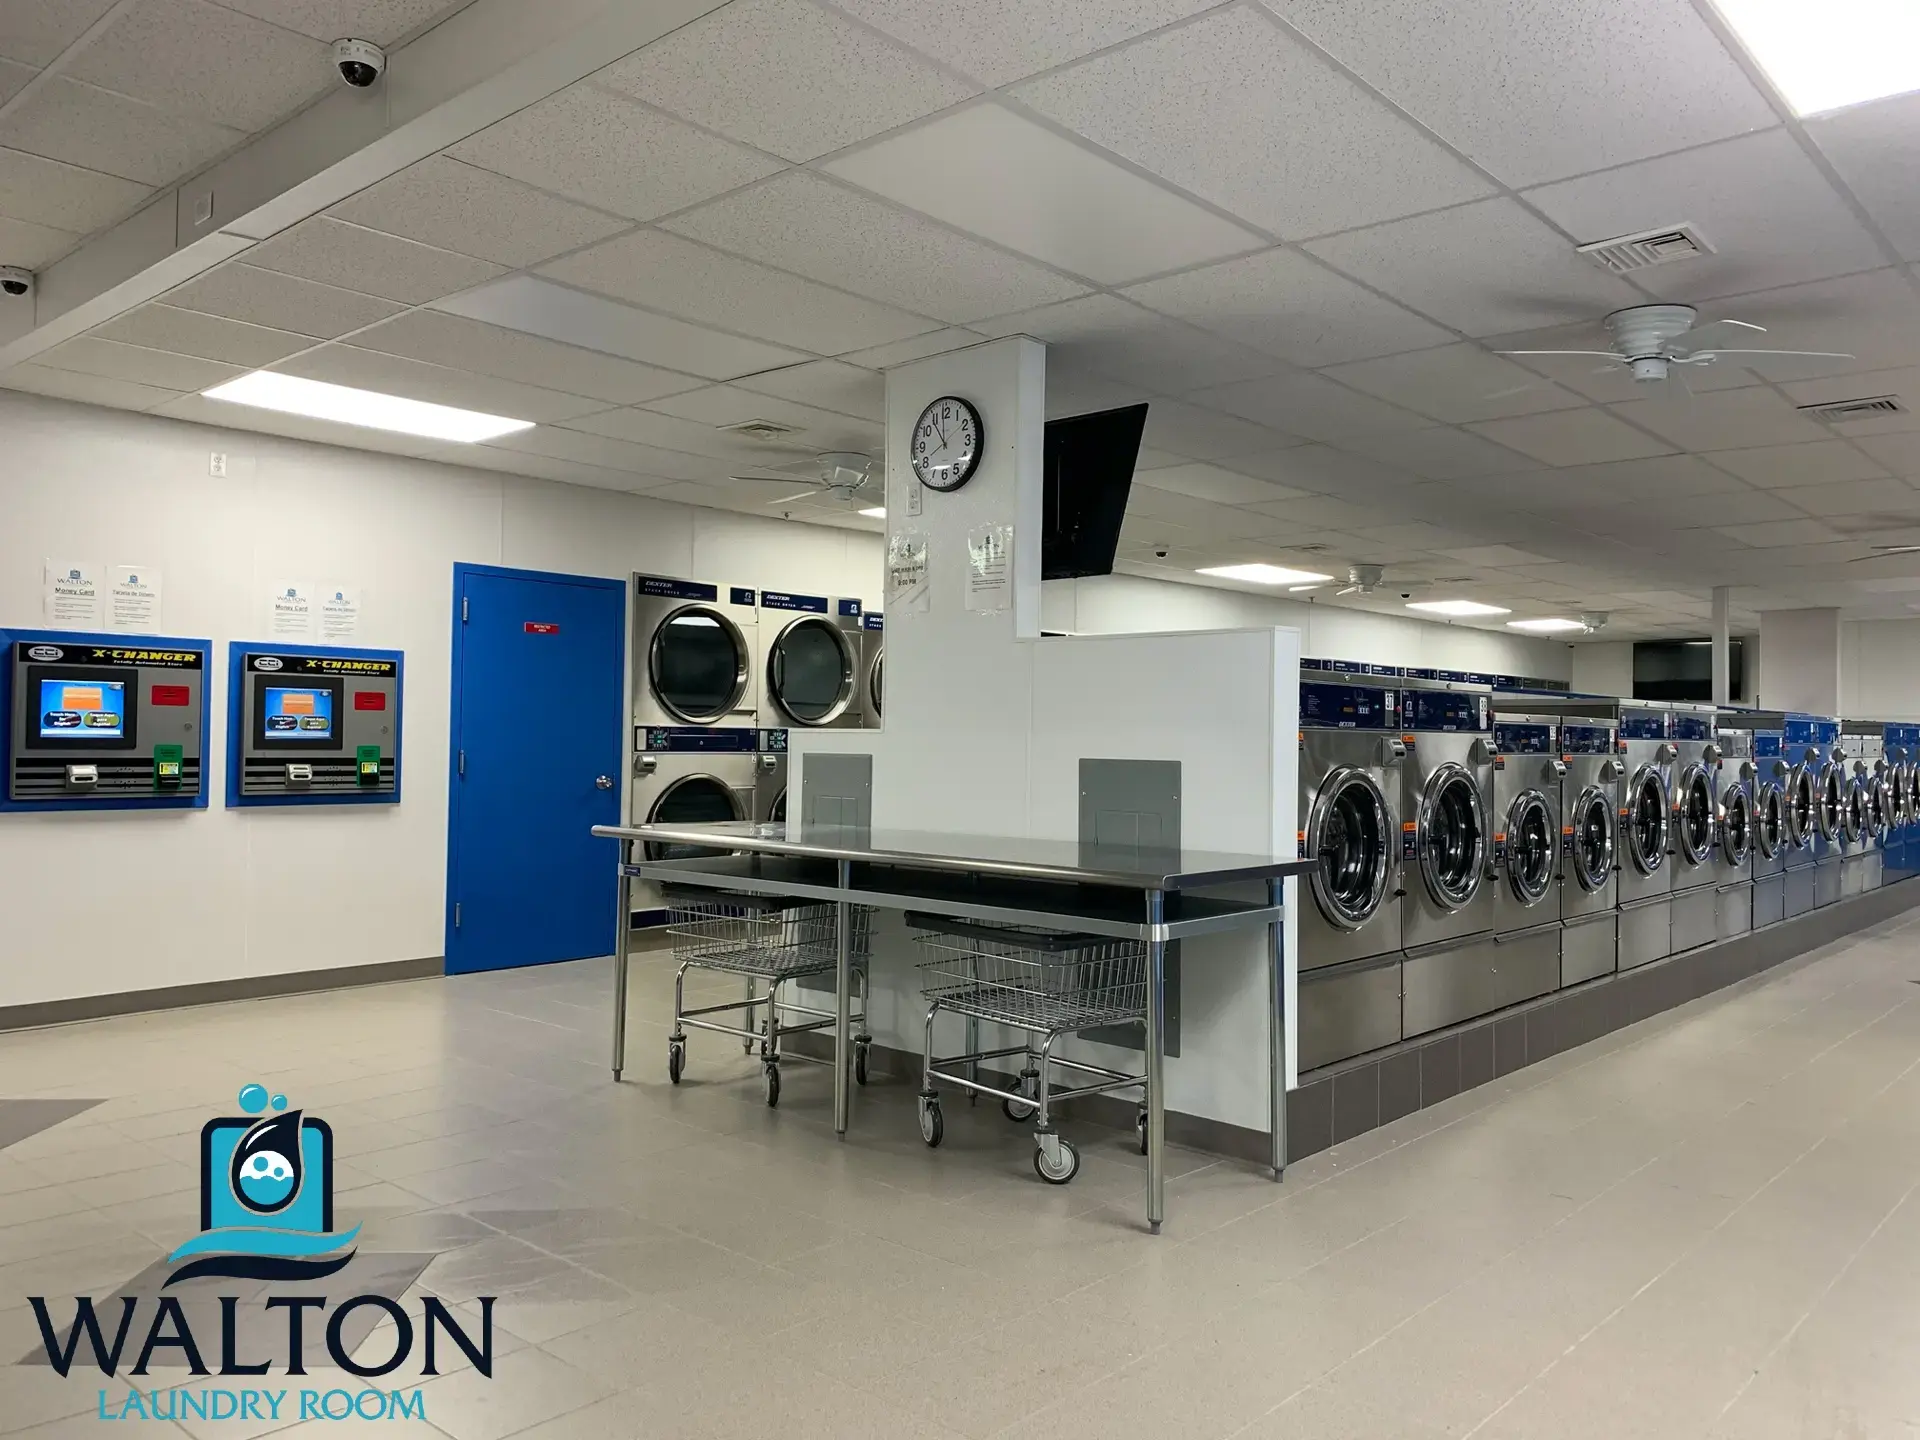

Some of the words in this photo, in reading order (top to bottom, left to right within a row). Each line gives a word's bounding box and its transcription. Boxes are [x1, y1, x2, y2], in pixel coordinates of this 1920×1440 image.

[956, 410, 959, 421] 1
[962, 419, 968, 431] 2
[922, 425, 932, 438] 10
[965, 434, 971, 446] 3
[920, 442, 926, 453] 9
[923, 456, 929, 469] 8
[942, 468, 948, 480] 6
[953, 463, 960, 476] 5
[56, 578, 92, 586] WALTON
[55, 587, 76, 595] Money
[92, 649, 196, 661] X-CHANGER
[306, 660, 391, 671] X-CHANGER
